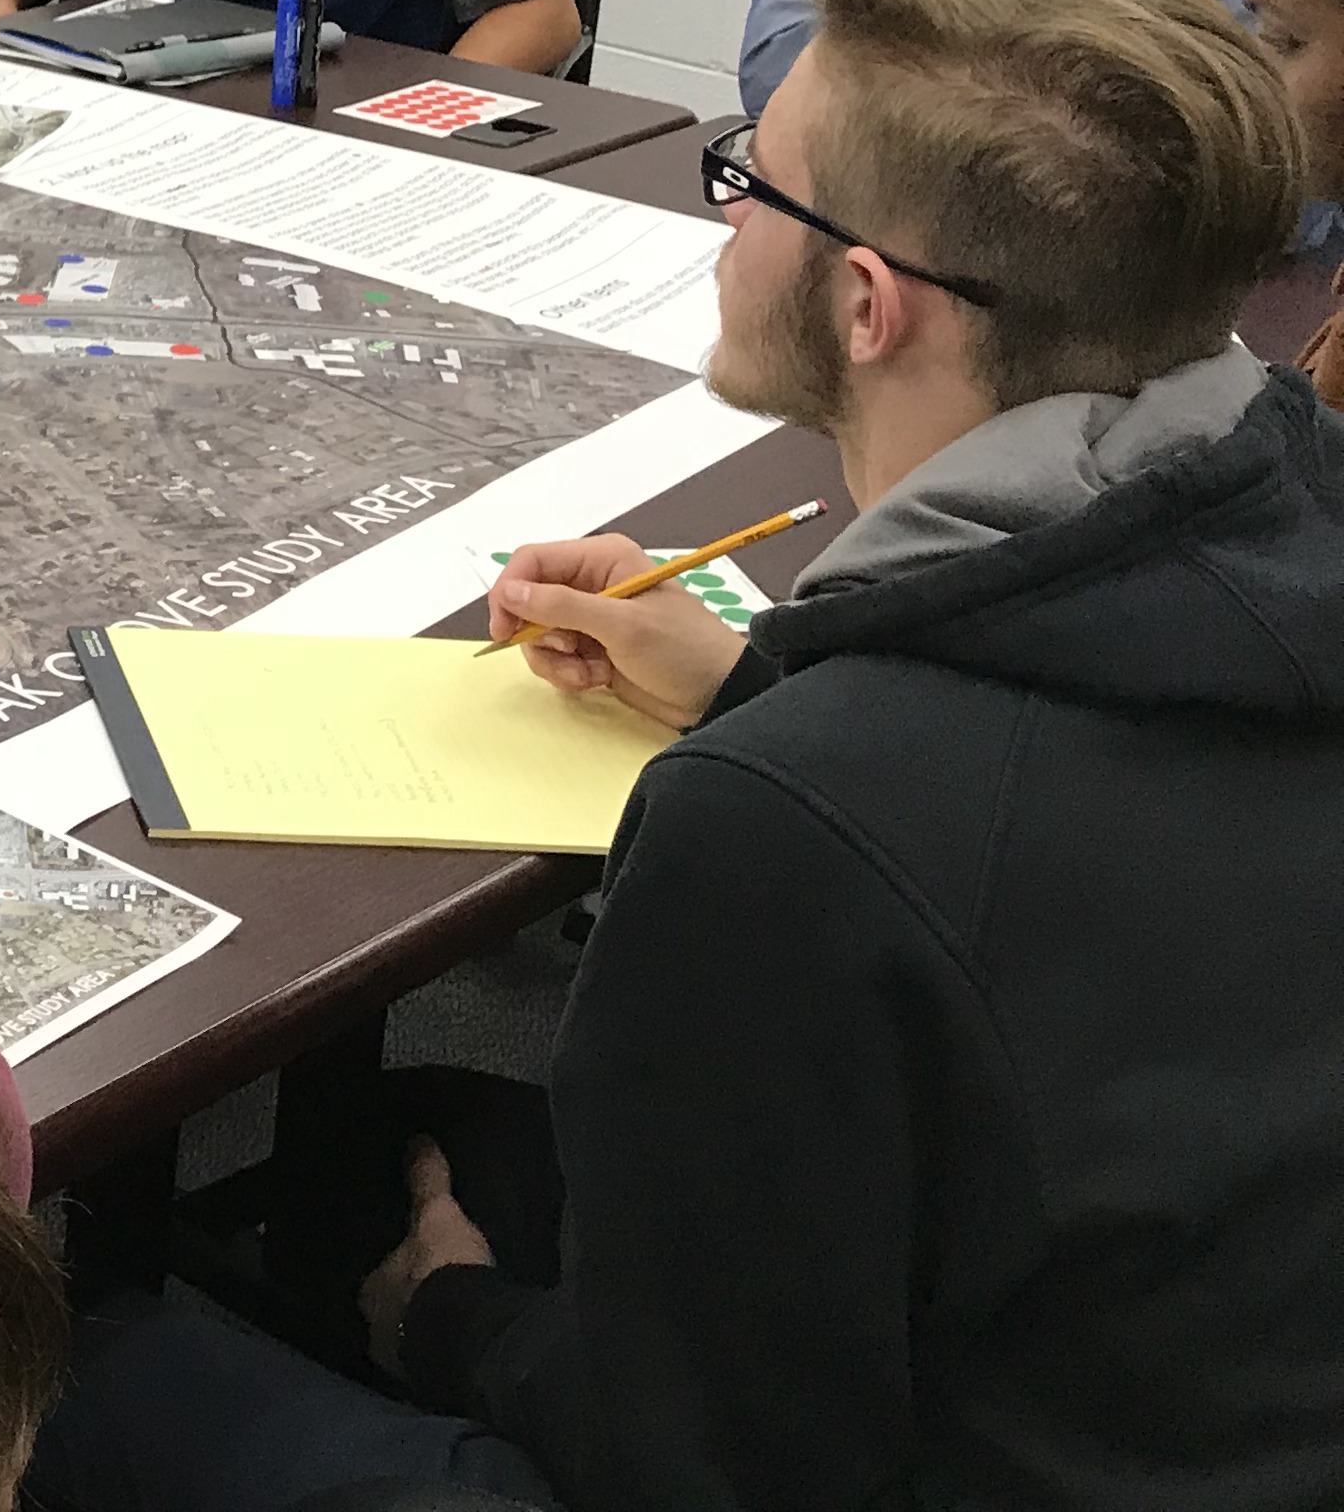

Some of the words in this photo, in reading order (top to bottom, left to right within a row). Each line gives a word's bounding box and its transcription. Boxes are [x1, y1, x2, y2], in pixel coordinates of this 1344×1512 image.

[201, 524, 345, 599] STUDY
[332, 475, 456, 535] AREA
[16, 991, 72, 1026] STUDY
[67, 969, 116, 998] AREA
